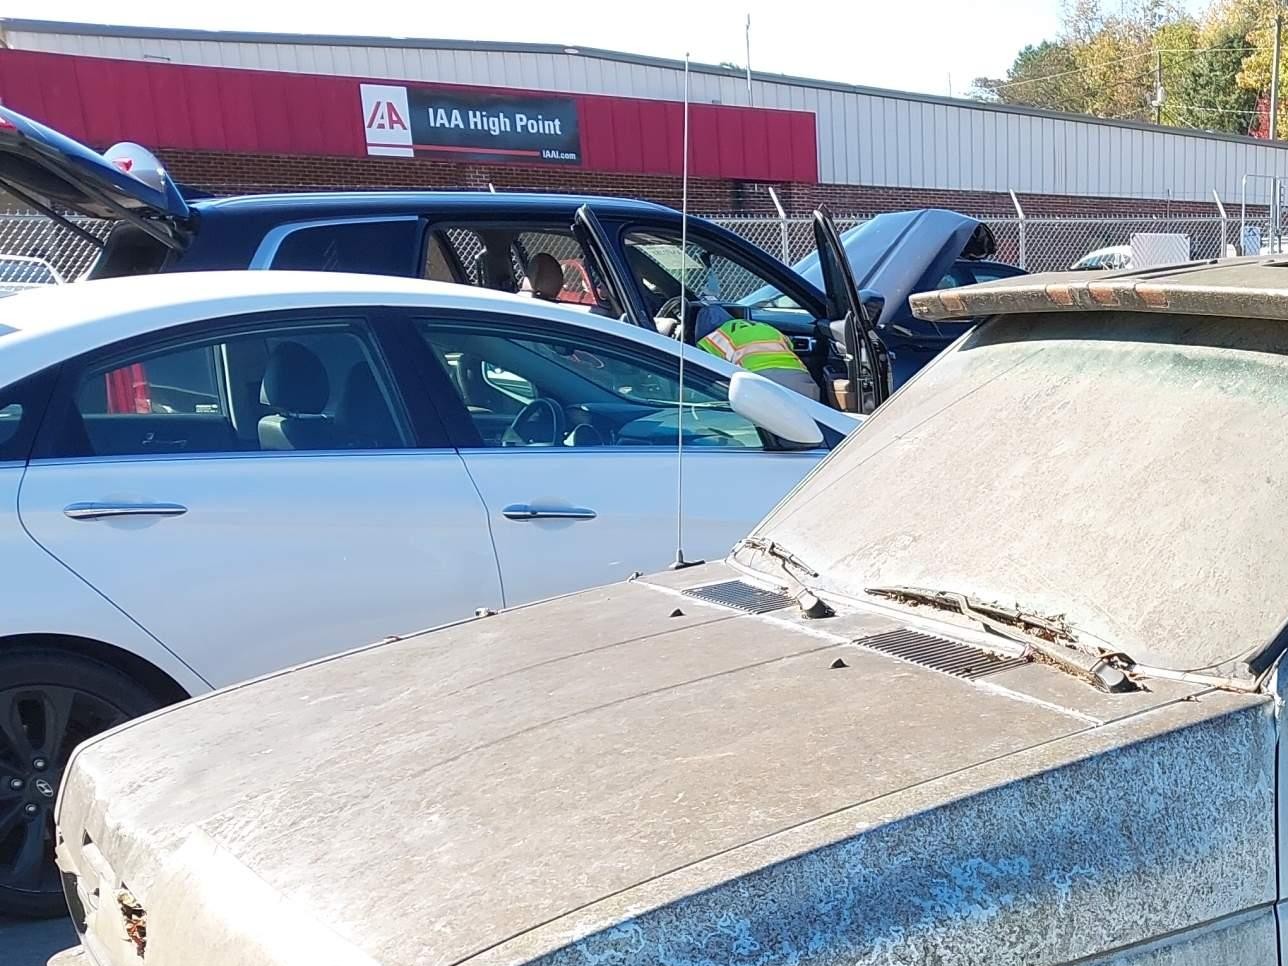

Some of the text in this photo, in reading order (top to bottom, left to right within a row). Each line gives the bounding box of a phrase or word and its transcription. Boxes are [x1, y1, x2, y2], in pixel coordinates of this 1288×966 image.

[428, 107, 562, 136] IAA High Point
